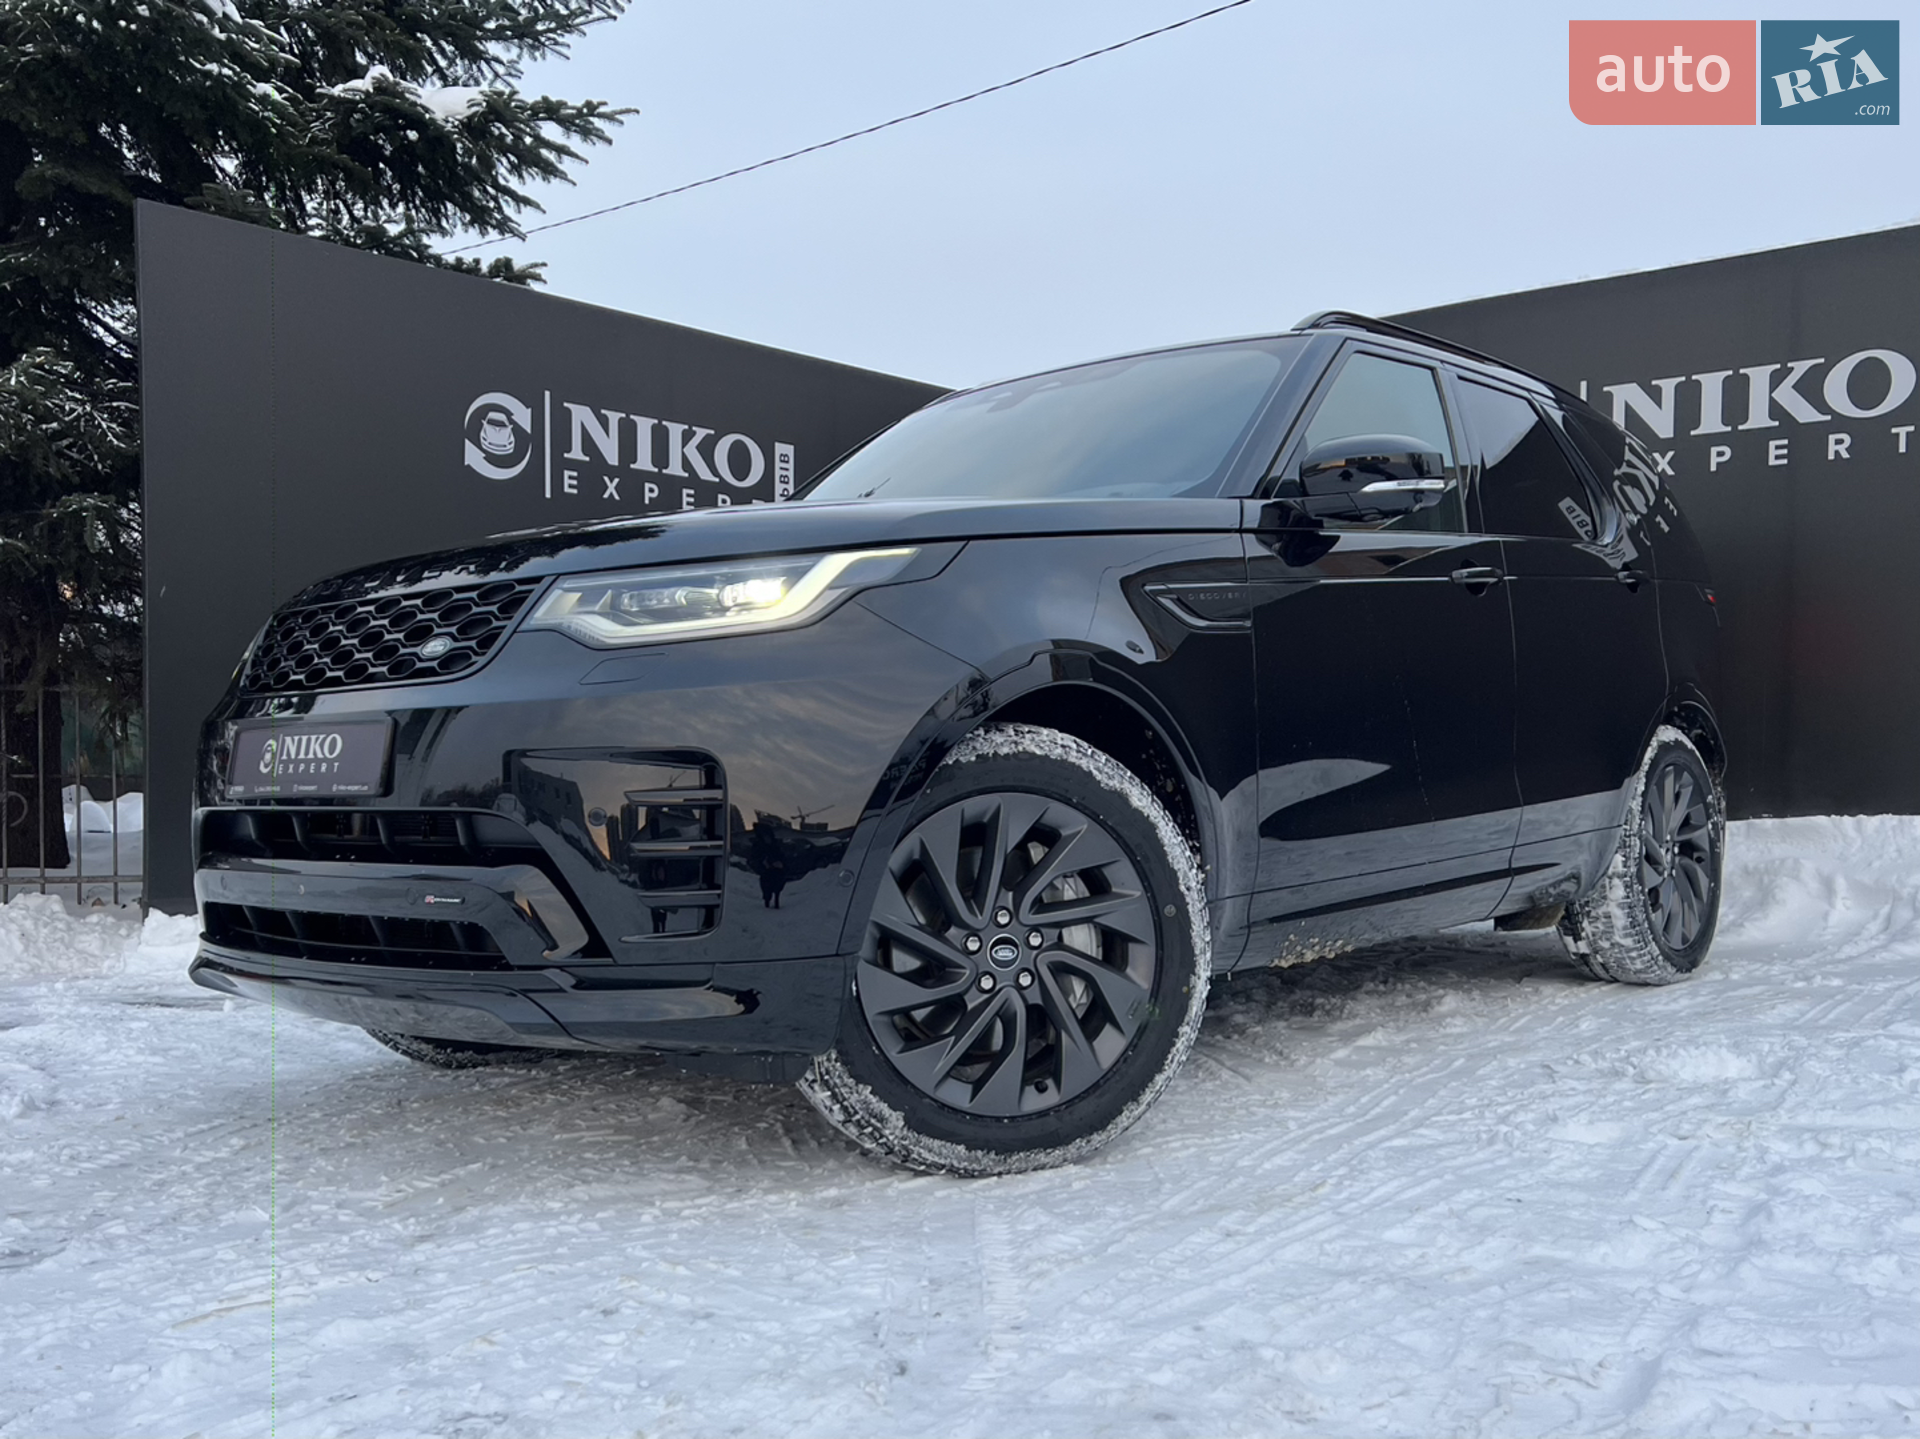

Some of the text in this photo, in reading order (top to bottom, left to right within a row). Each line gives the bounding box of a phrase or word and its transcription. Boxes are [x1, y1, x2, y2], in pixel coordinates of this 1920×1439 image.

[1602, 348, 1917, 439] NIKO
[563, 401, 765, 488] NIKO
[1651, 425, 1916, 476] XPERT
[563, 470, 766, 510] EXPER
[779, 452, 790, 498] ЬВІВ
[279, 762, 339, 773] EXPERT
[281, 734, 342, 759] NIKO
